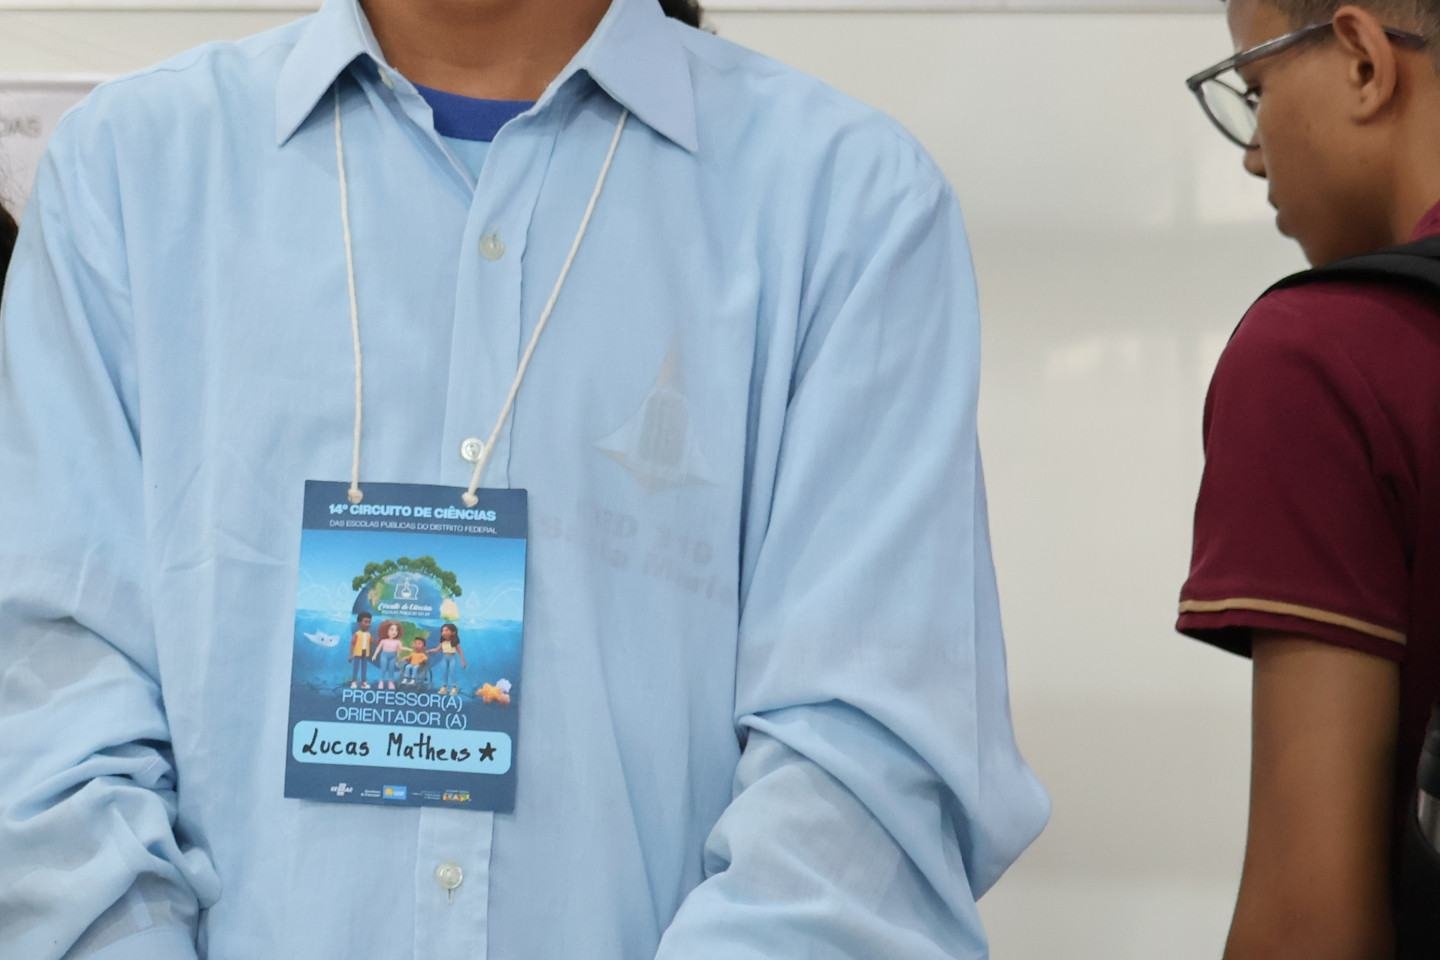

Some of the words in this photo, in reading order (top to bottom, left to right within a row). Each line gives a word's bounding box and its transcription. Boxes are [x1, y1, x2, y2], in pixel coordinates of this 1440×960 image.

[349, 504, 412, 517] CIRCUITO
[413, 506, 432, 518] DE
[433, 505, 497, 522] CIÊNCIAS
[329, 519, 345, 528] DAS
[346, 520, 379, 529] ESCOLAS
[417, 522, 429, 530] DO
[430, 523, 464, 532] DISTRITO
[464, 525, 498, 534] FEDERAL
[342, 690, 463, 712] PROFESSOR(A)
[335, 706, 441, 726] ORIENTADOR
[445, 713, 467, 730] (A)
[301, 727, 370, 757] Lucas
[386, 731, 471, 762] Matheus
